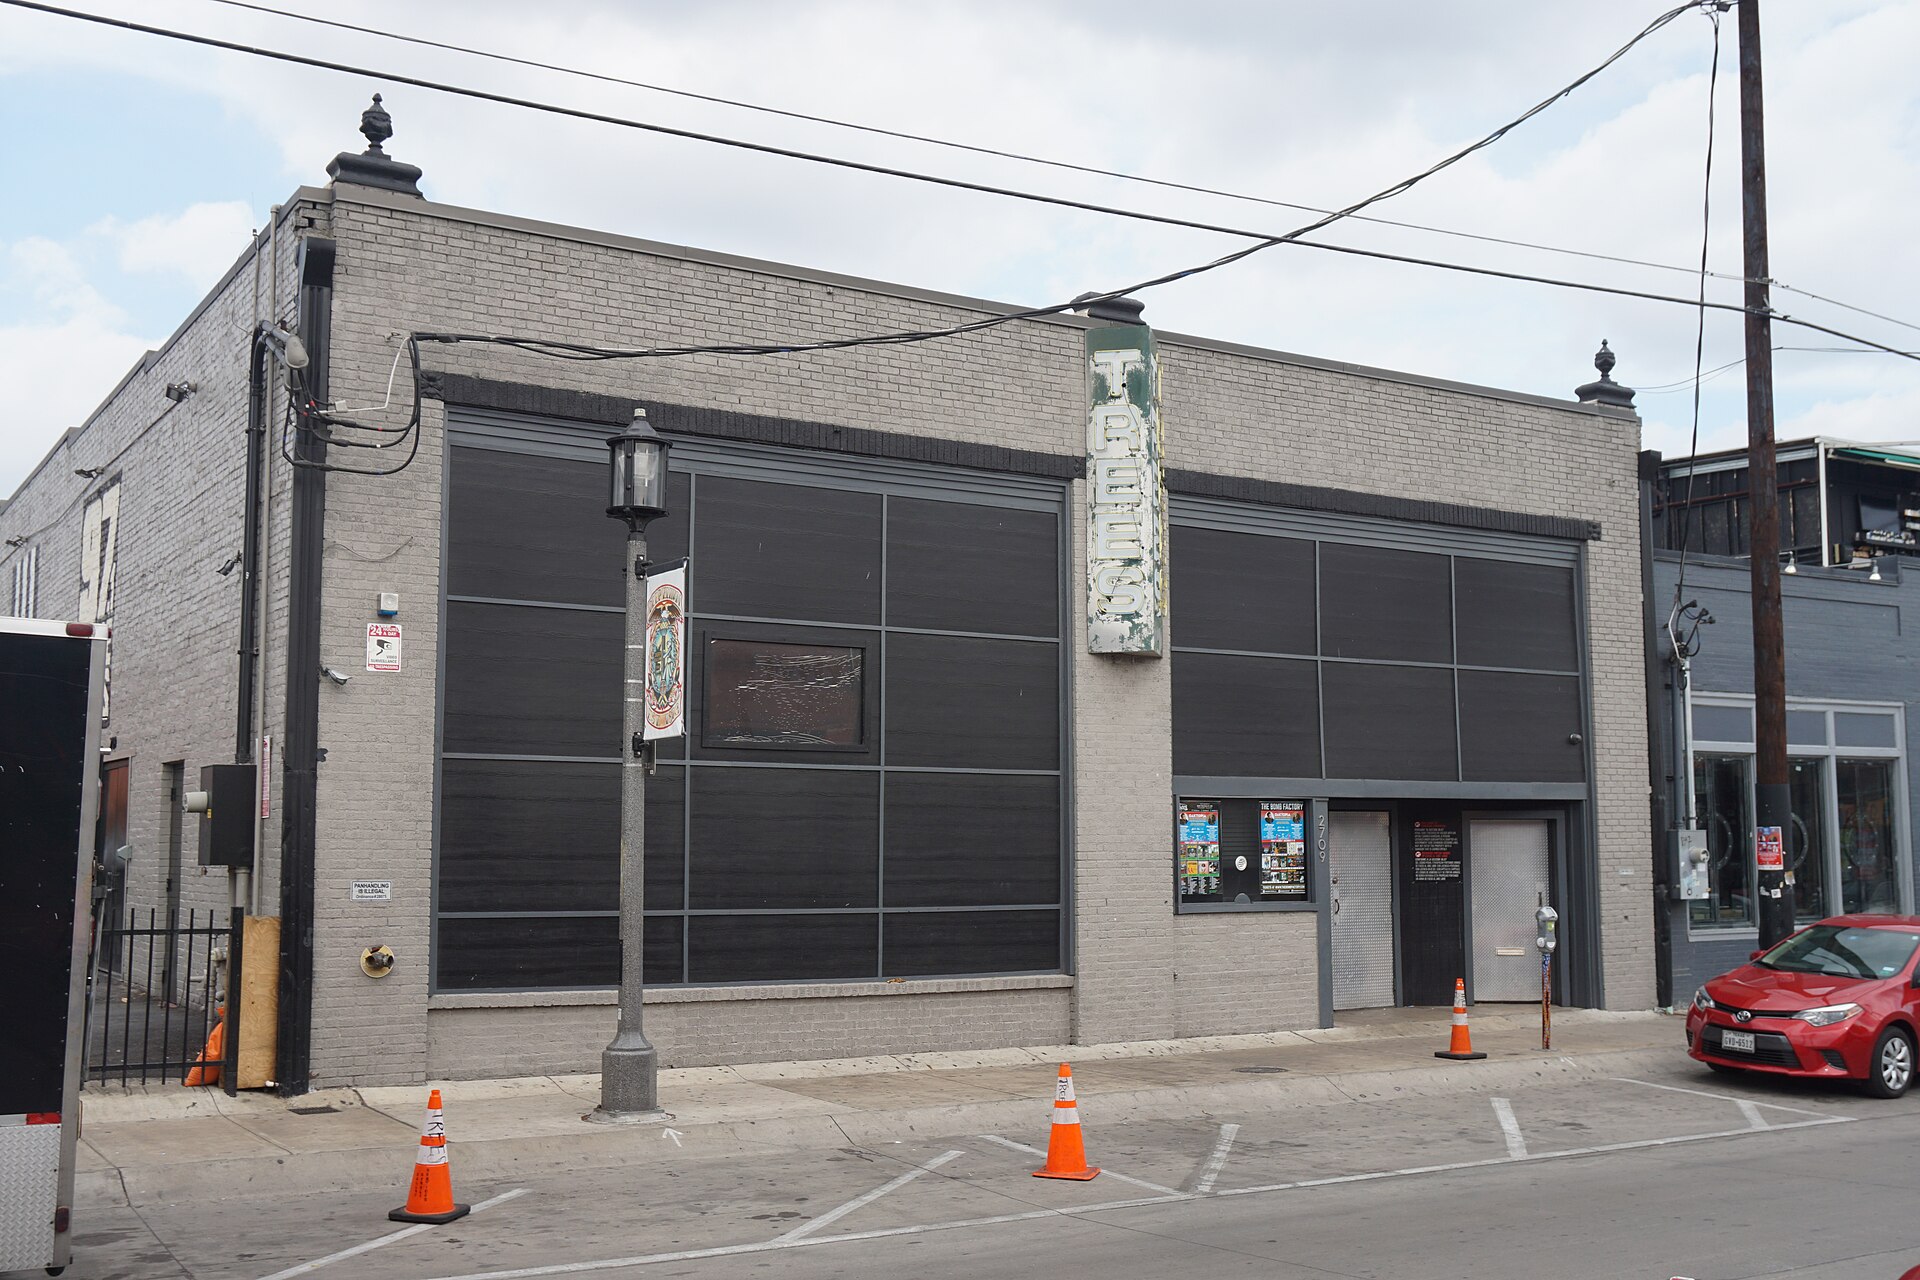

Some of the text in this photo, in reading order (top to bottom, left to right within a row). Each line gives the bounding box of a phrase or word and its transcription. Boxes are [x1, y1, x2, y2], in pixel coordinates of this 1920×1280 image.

[1094, 348, 1145, 615] TREES
[370, 625, 382, 636] 24
[1318, 815, 1327, 863] 2709
